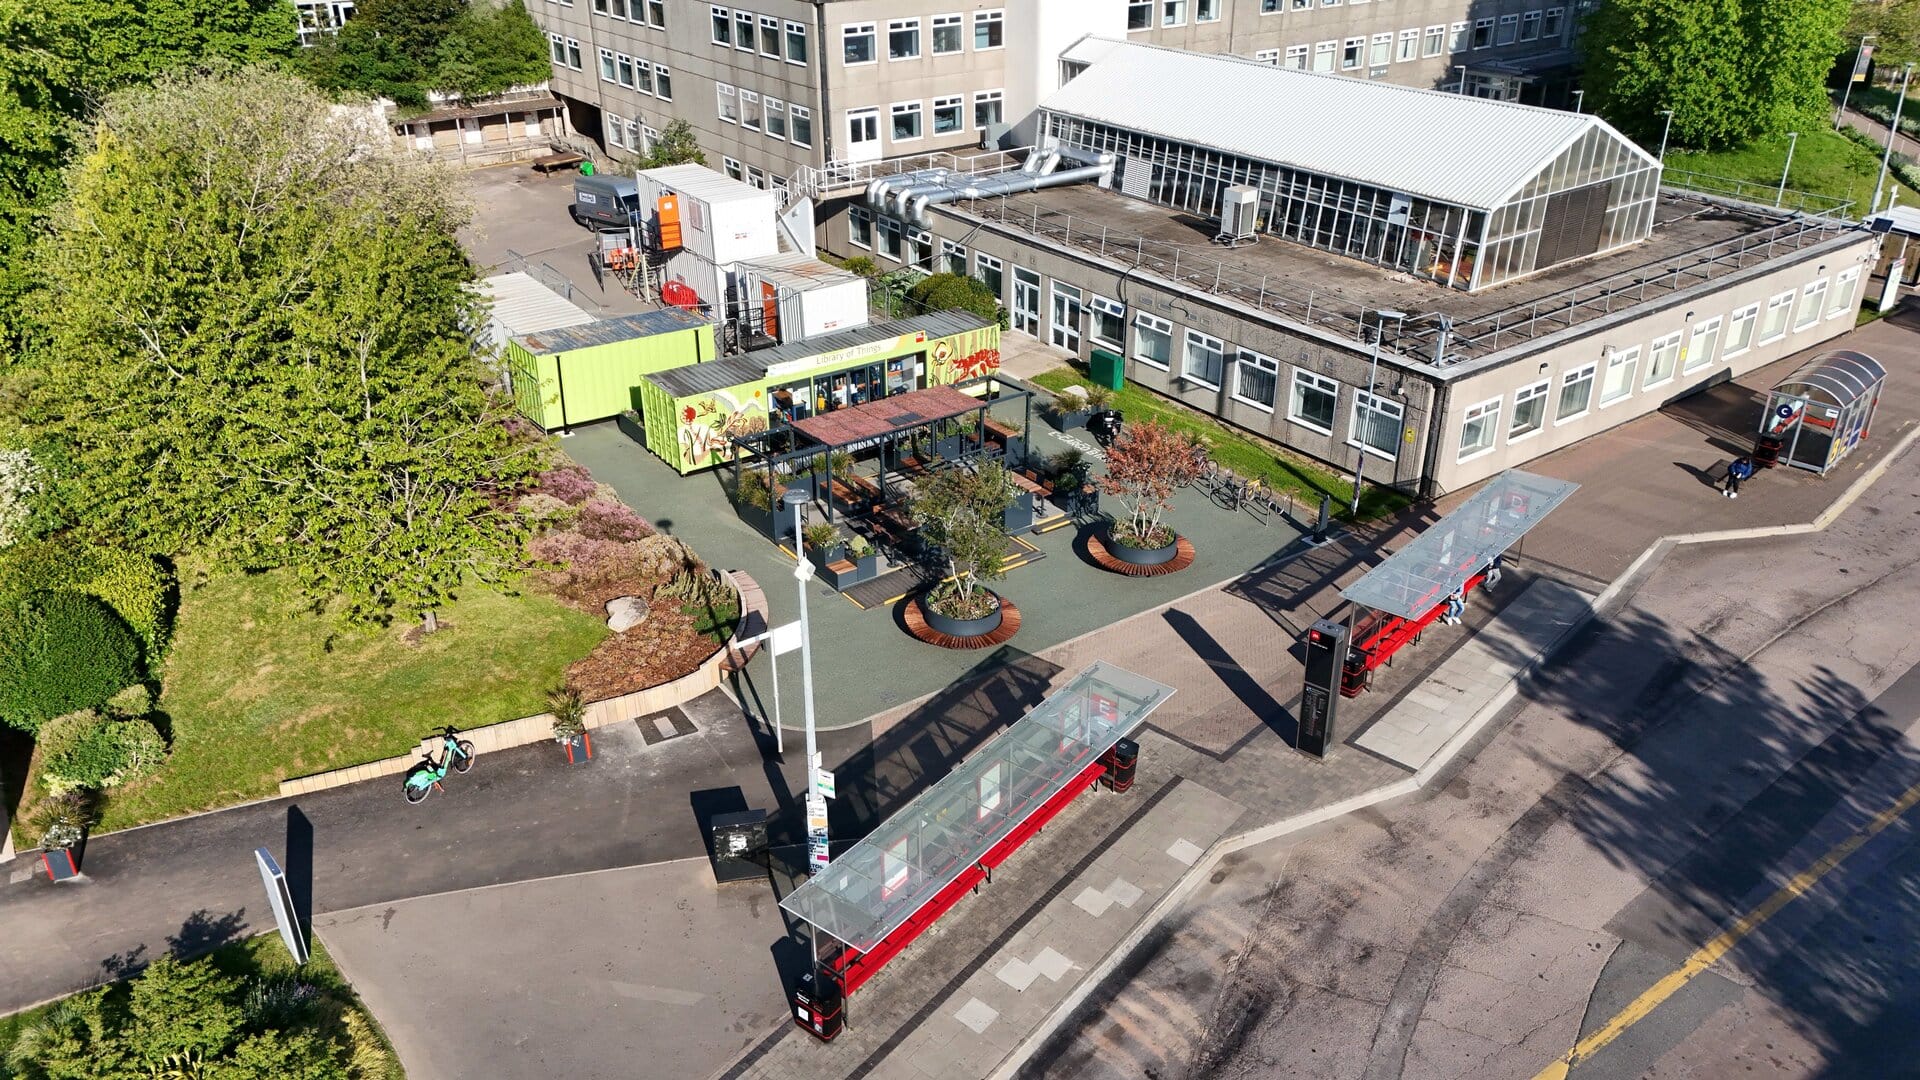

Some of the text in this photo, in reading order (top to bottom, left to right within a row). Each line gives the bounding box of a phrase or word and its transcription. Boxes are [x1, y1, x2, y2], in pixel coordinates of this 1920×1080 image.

[816, 344, 881, 365] Library of Things
[1781, 407, 1789, 416] C
